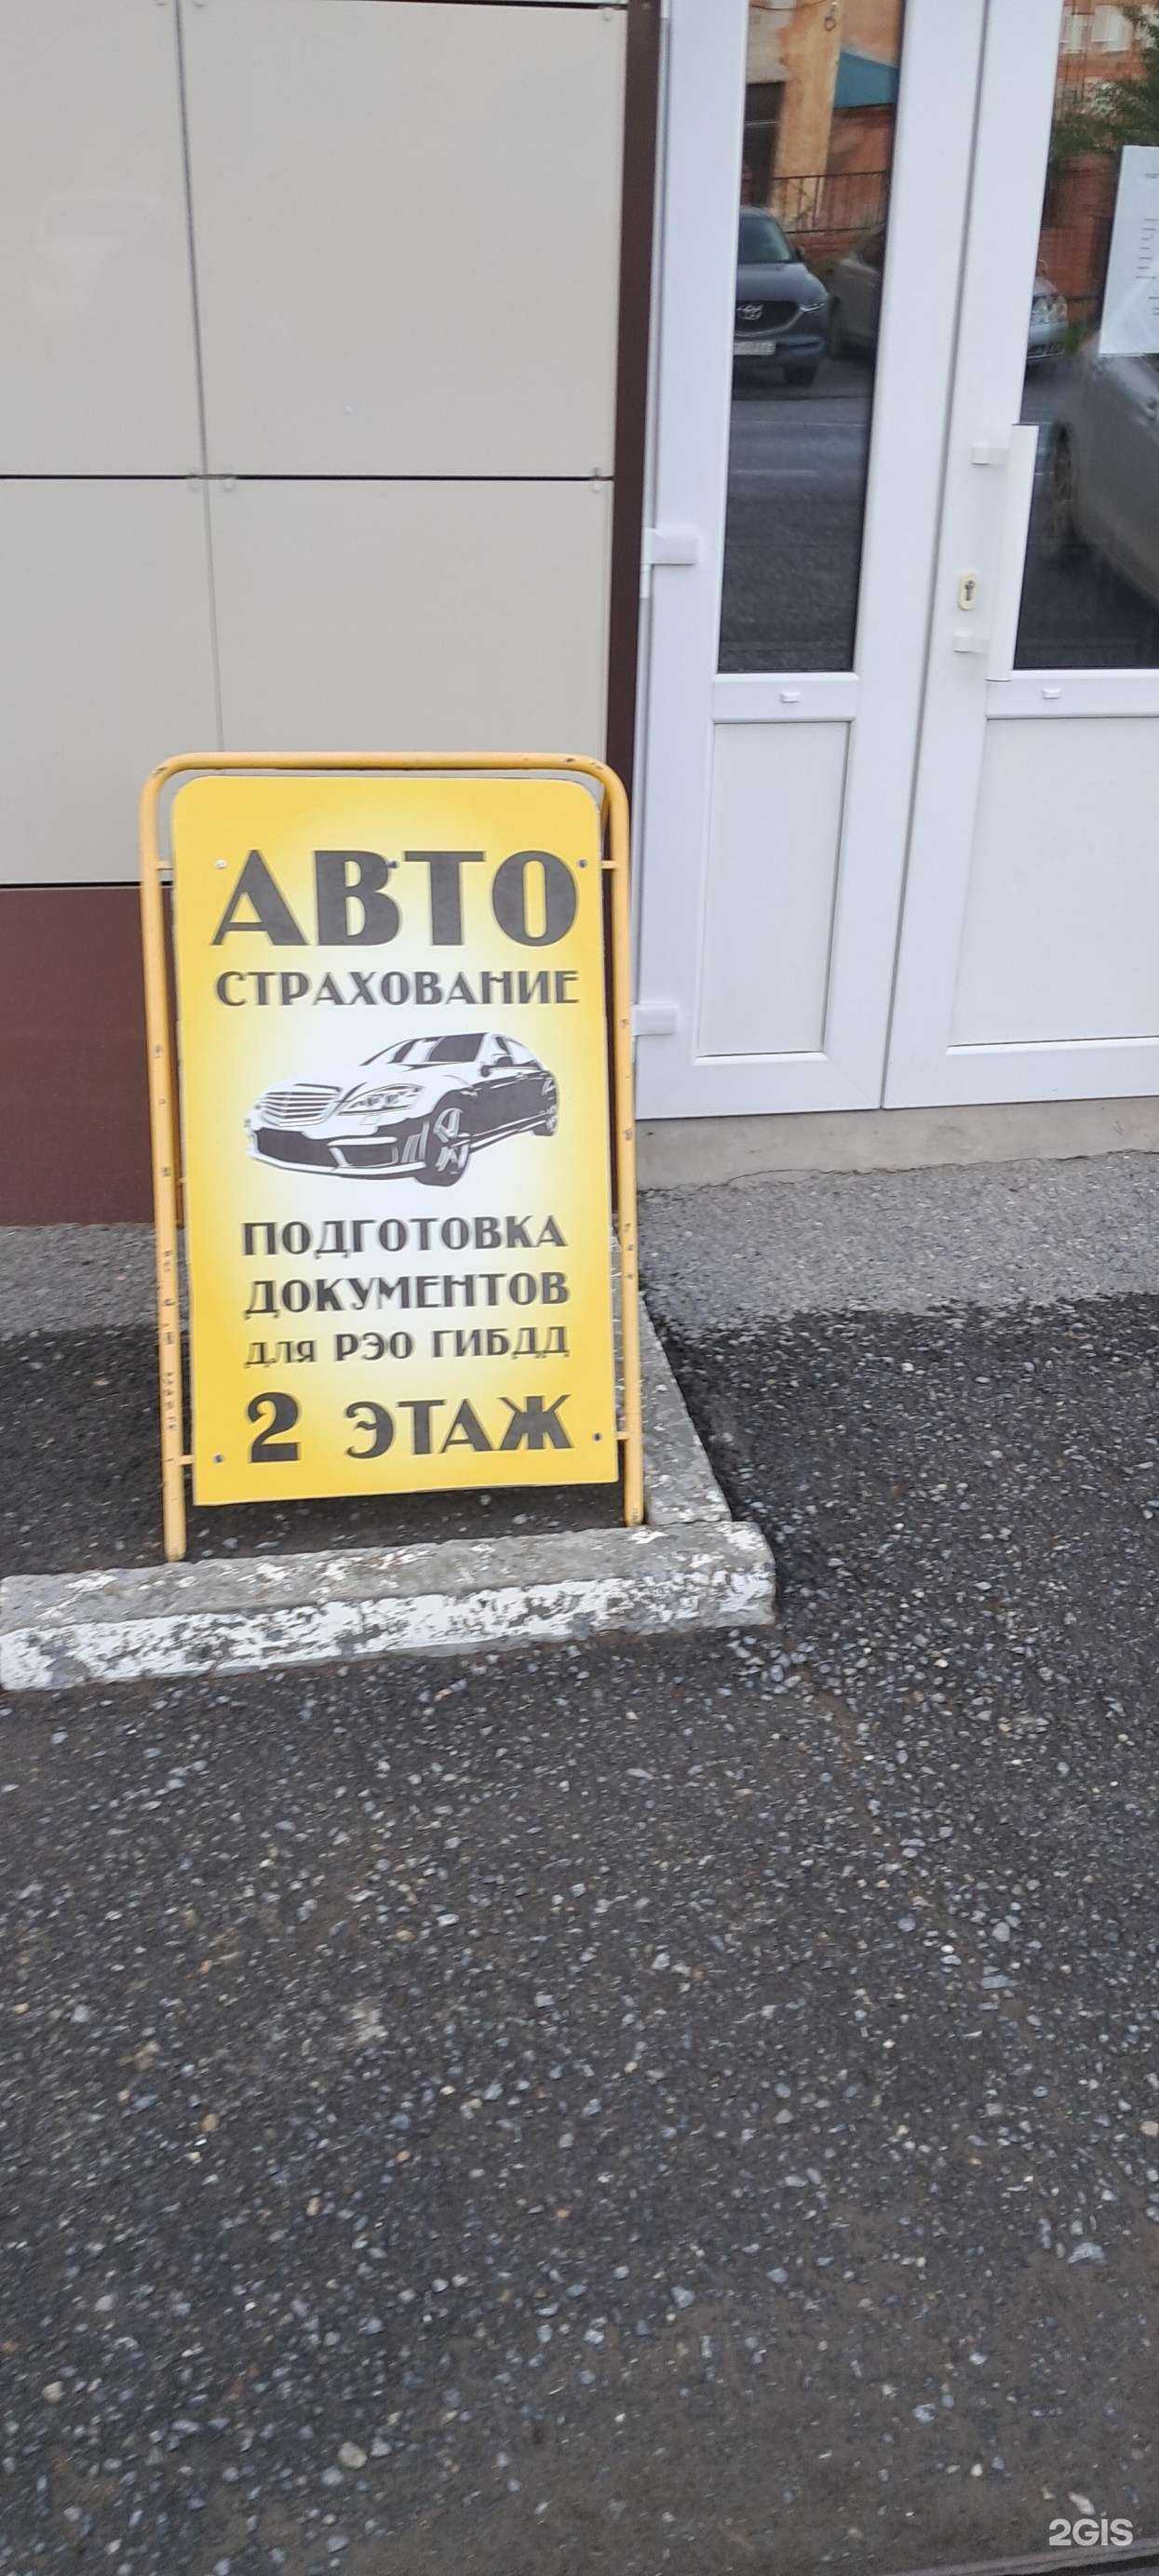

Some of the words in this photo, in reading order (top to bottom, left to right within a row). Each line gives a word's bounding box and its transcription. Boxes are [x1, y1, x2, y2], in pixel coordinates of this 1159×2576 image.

[210, 850, 578, 946] АВТО
[215, 970, 579, 1006] СТРАХОВАНИЕ
[241, 1215, 568, 1259] ПОДГОТОВКА
[244, 1271, 570, 1320] ДОКУМЕНТОВ
[244, 1340, 317, 1369] для
[335, 1332, 413, 1362] РЭО
[432, 1326, 570, 1360] ГИБДД
[247, 1391, 300, 1463] 2
[344, 1394, 573, 1460] ЭТАЖ
